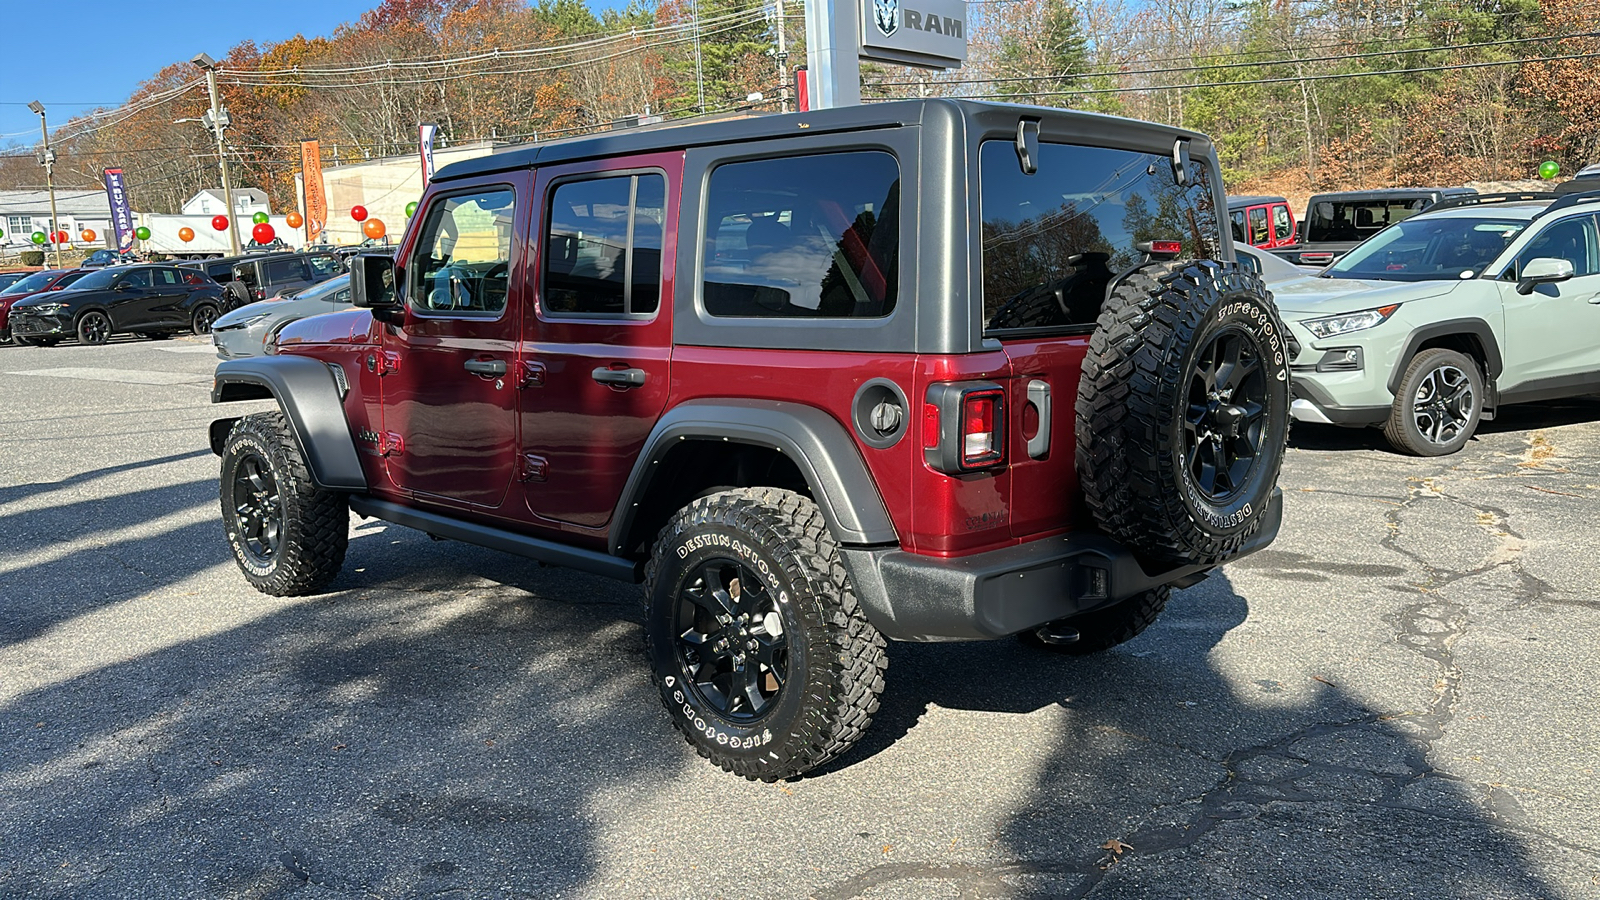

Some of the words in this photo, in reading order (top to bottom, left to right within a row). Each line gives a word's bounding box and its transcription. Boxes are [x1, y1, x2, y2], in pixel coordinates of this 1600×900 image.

[904, 9, 962, 38] RAM
[109, 173, 120, 187] WE
[113, 188, 124, 206] BUY
[116, 207, 129, 230] CARS
[1218, 302, 1283, 366] Firestone
[358, 426, 379, 447] Jeep
[1182, 469, 1252, 528] DESTINATION
[676, 534, 780, 589] DESTINATION
[673, 689, 773, 749] Firestone
